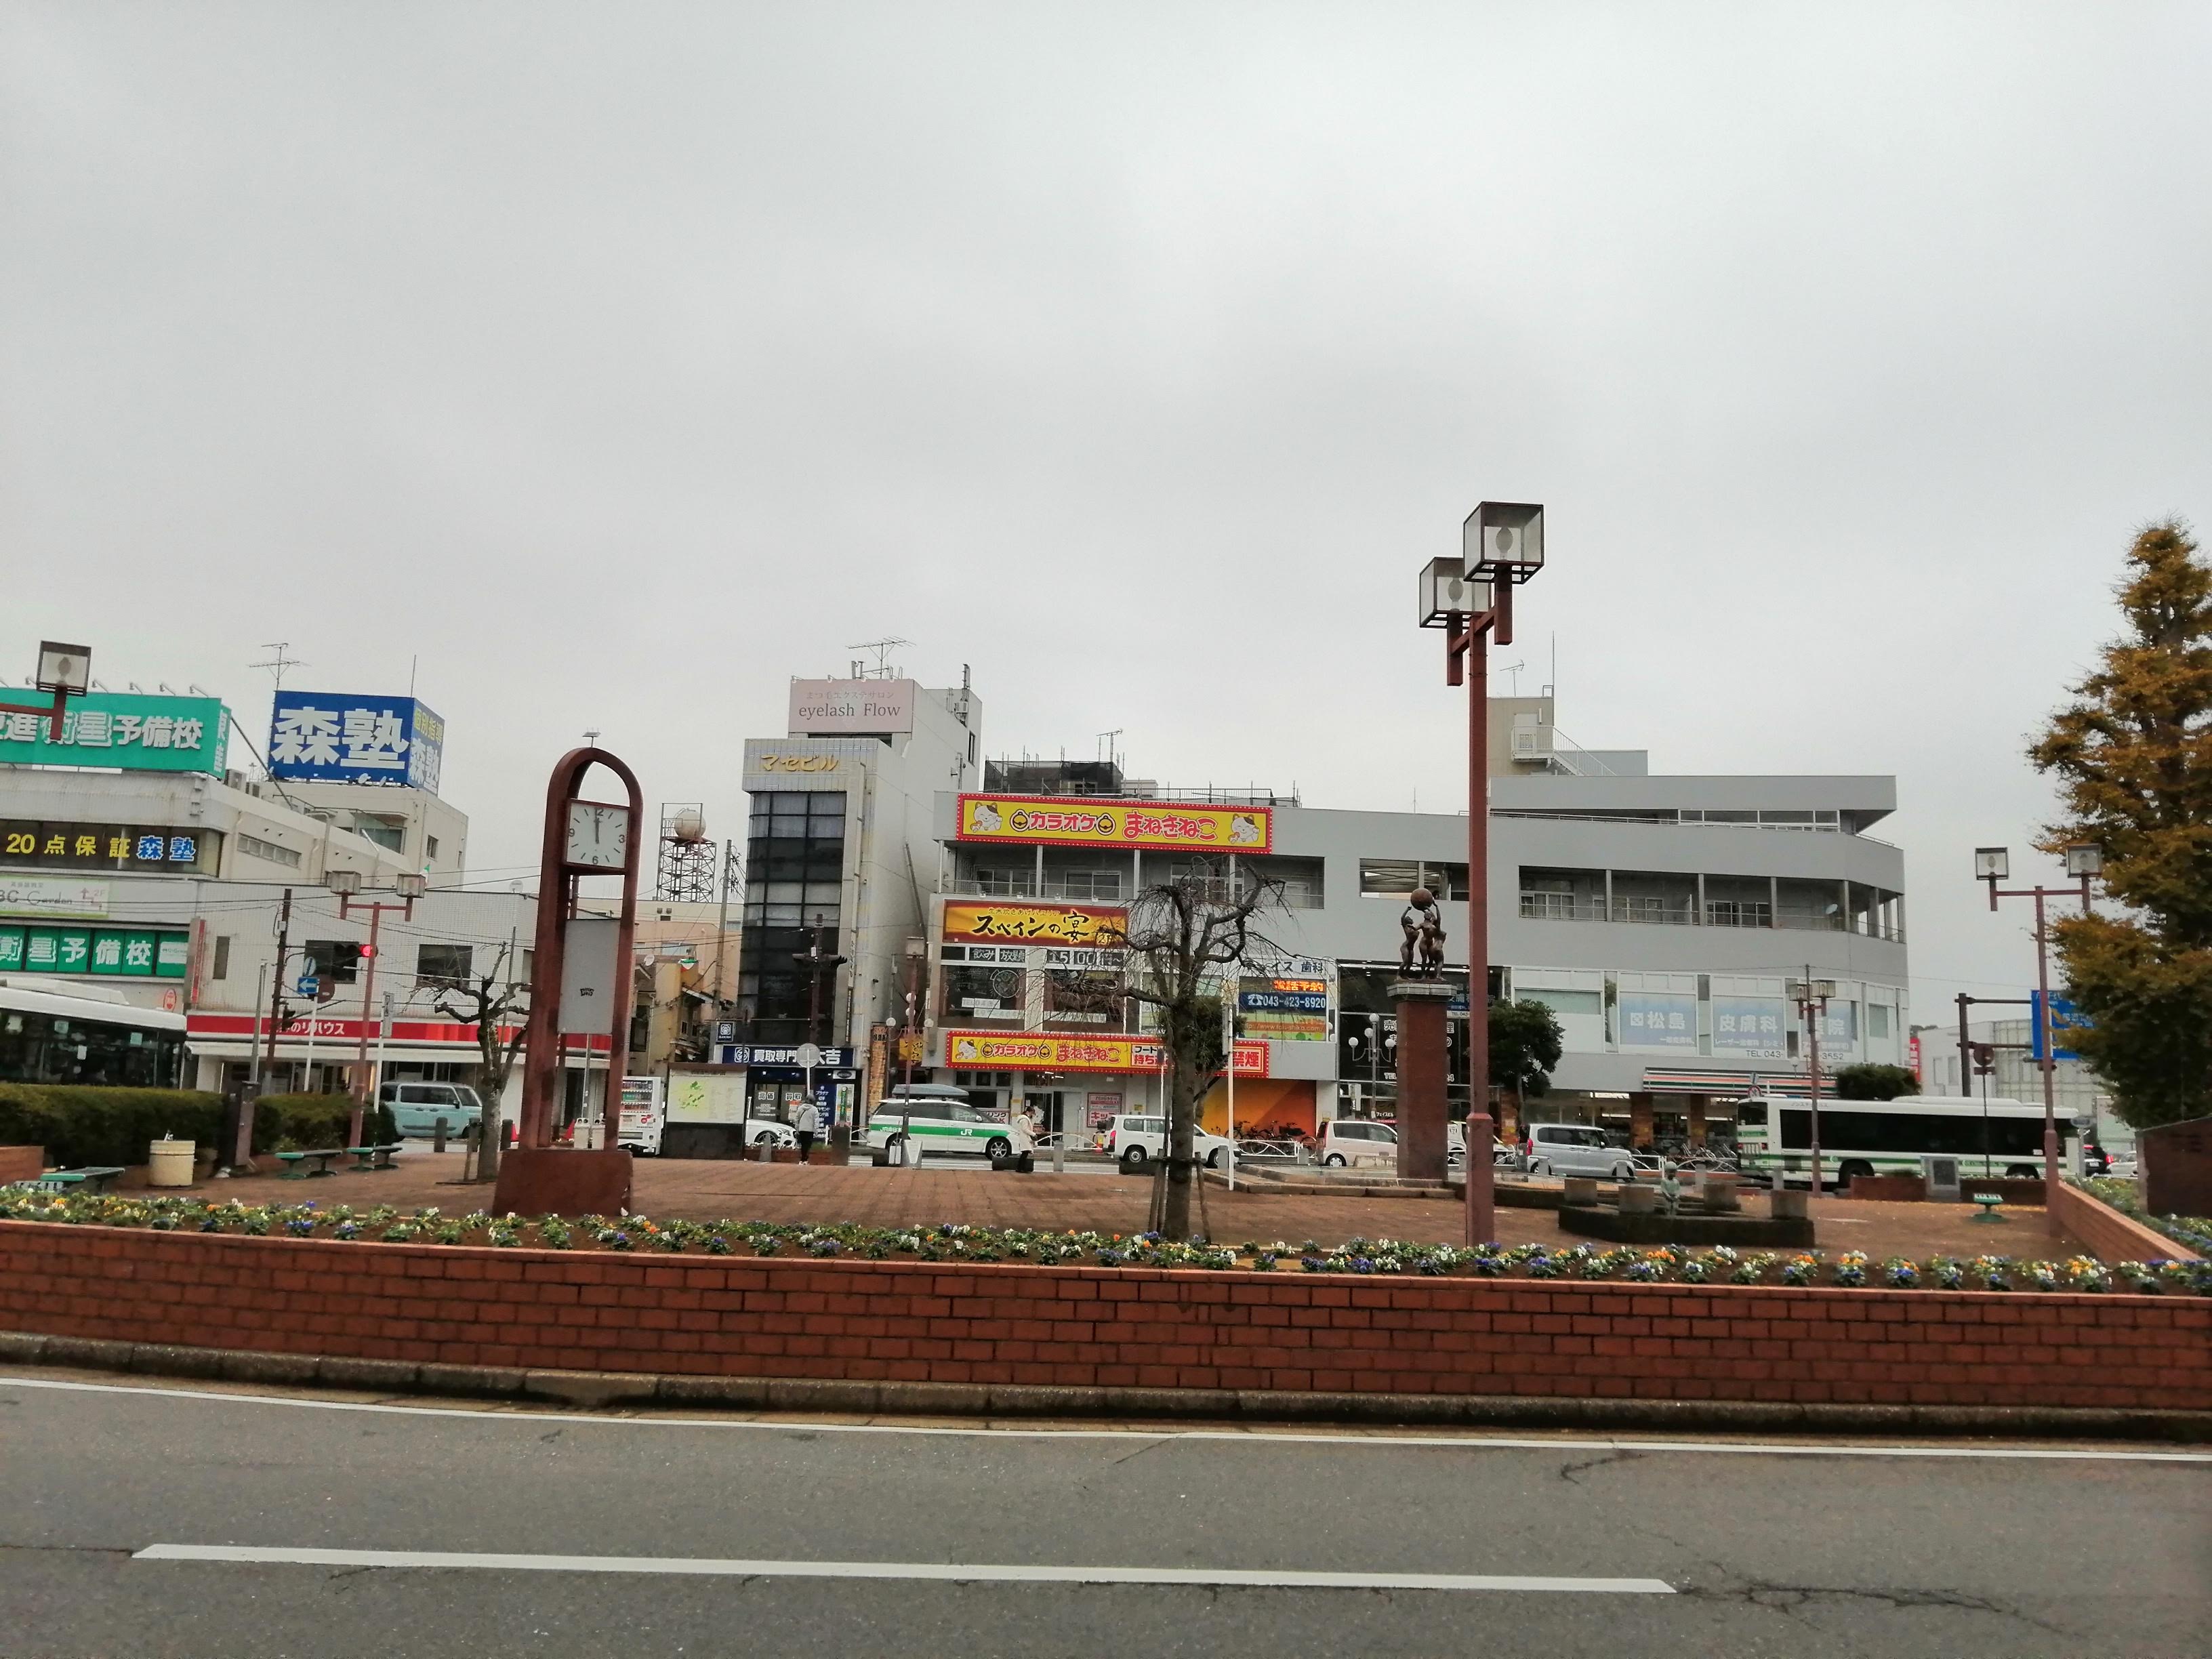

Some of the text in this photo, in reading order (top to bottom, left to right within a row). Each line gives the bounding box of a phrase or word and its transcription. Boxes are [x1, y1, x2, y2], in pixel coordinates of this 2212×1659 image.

[806, 691, 895, 699] まつ毛エクステサロン
[798, 703, 901, 720] eyelash Flow
[270, 706, 410, 770] 森塾
[409, 737, 439, 794] 森塾
[760, 754, 840, 772] マセビル
[1028, 811, 1098, 832] カラオケ
[1122, 809, 1218, 841] まねきねこ
[569, 827, 575, 838] 9
[617, 834, 625, 844] 3
[136, 835, 197, 862] 森塾
[592, 855, 599, 865] 6
[971, 910, 1090, 943] スペインの宴
[1301, 962, 1324, 973] 歯科
[1647, 1011, 1685, 1029] 松島
[1719, 1015, 1778, 1033] 皮膚科
[993, 1044, 1038, 1059] カラオケ
[1056, 1044, 1120, 1064] まねきねこ
